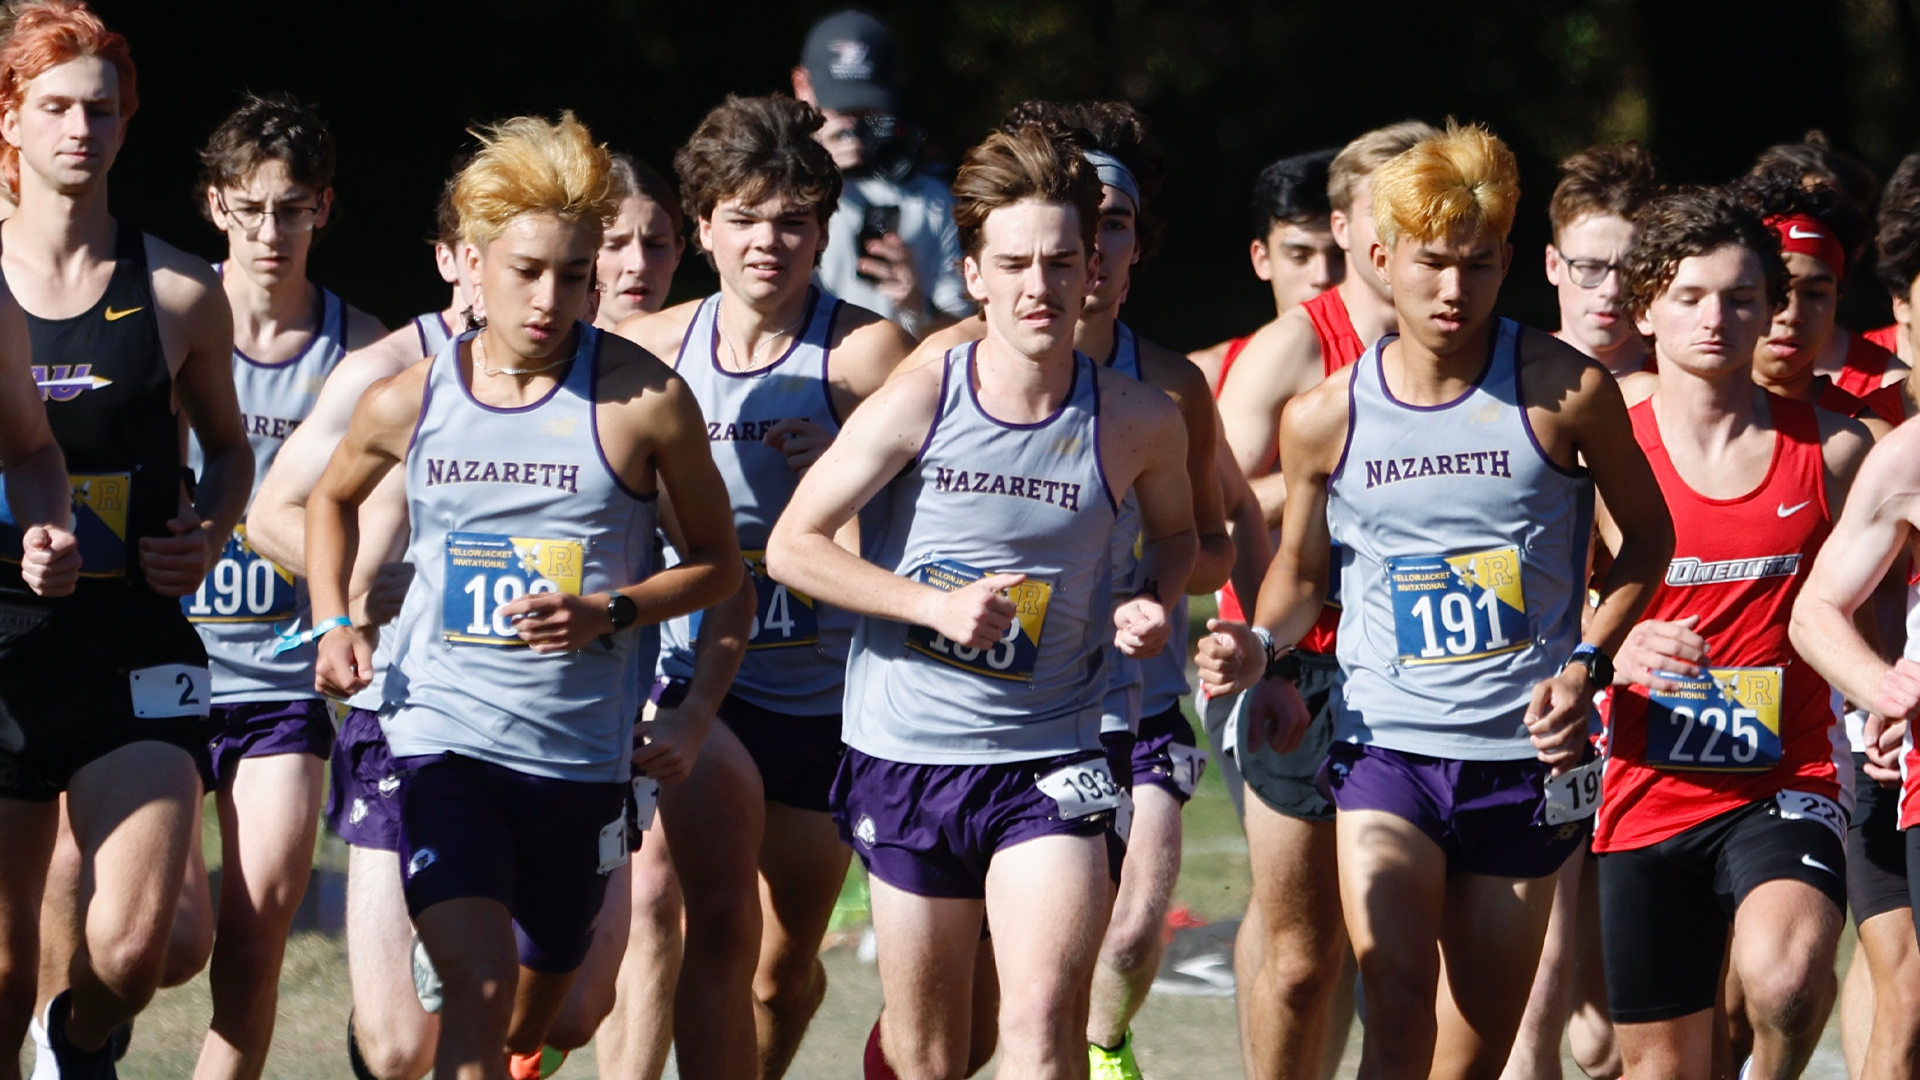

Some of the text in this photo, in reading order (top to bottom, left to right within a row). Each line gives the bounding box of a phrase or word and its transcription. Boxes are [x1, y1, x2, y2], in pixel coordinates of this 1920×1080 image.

[426, 459, 580, 494] NAZARETH
[1365, 450, 1512, 489] NAZARETH
[935, 467, 1081, 513] NAZARETH
[449, 547, 512, 559] YELLOWJACKET
[453, 558, 508, 570] INVITATIONAL
[1667, 554, 1802, 586] ONEONTA
[189, 558, 275, 615] 190
[1392, 571, 1451, 583] YELLOWJACKET
[1397, 582, 1447, 592] INVITATIONAL
[1411, 588, 1509, 658] 191
[175, 673, 199, 706] 2
[1668, 706, 1758, 764] 225
[1063, 768, 1117, 804] 193
[1566, 769, 1603, 810] 19
